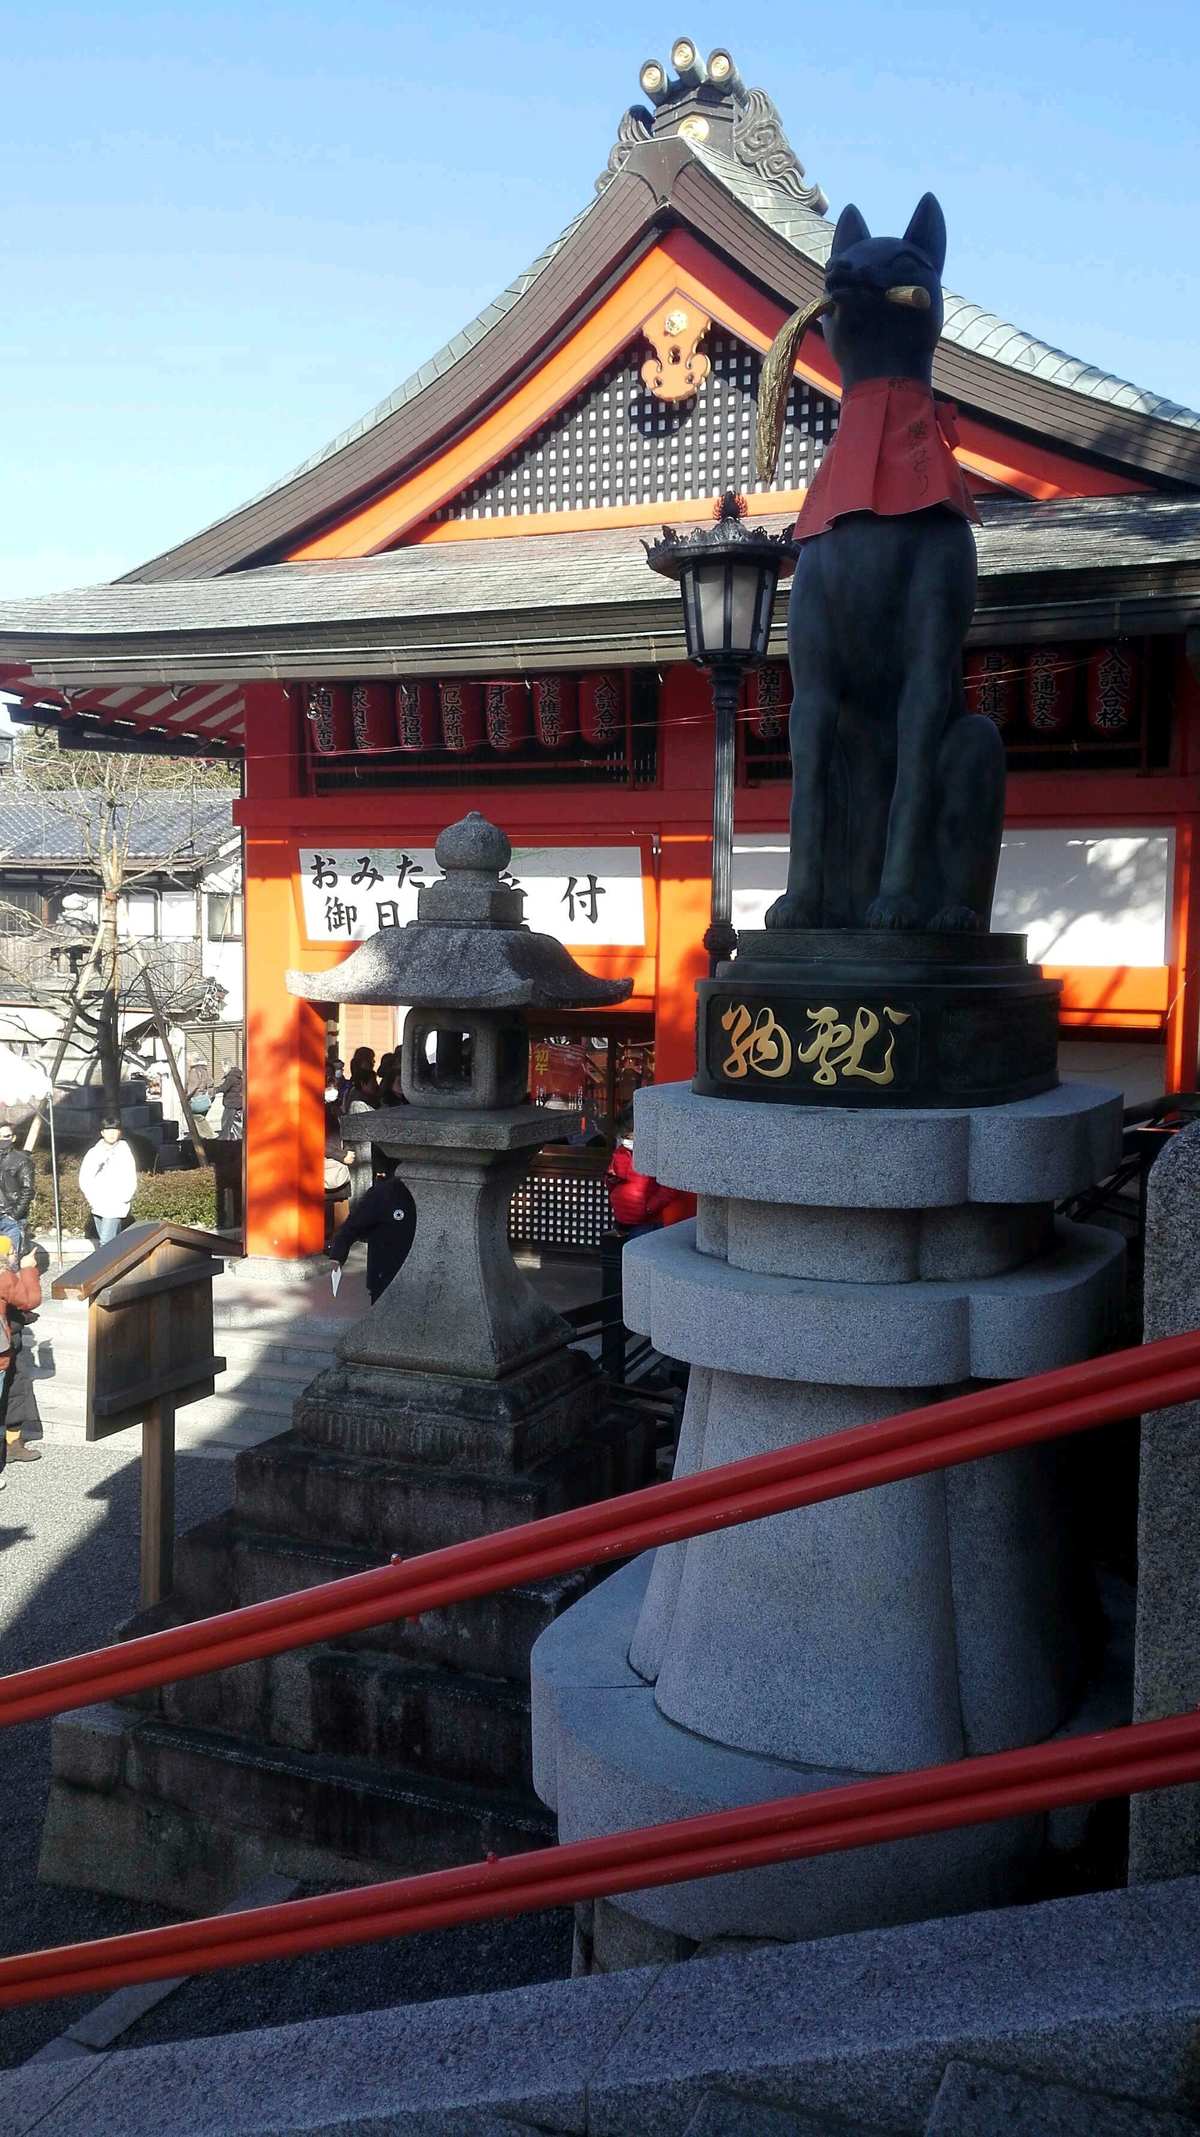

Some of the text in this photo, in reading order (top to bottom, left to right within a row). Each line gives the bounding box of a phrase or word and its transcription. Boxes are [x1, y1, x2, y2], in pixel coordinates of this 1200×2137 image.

[1031, 652, 1058, 728] 交通安全
[1096, 648, 1131, 729] 入試合格
[310, 854, 447, 890] おみた
